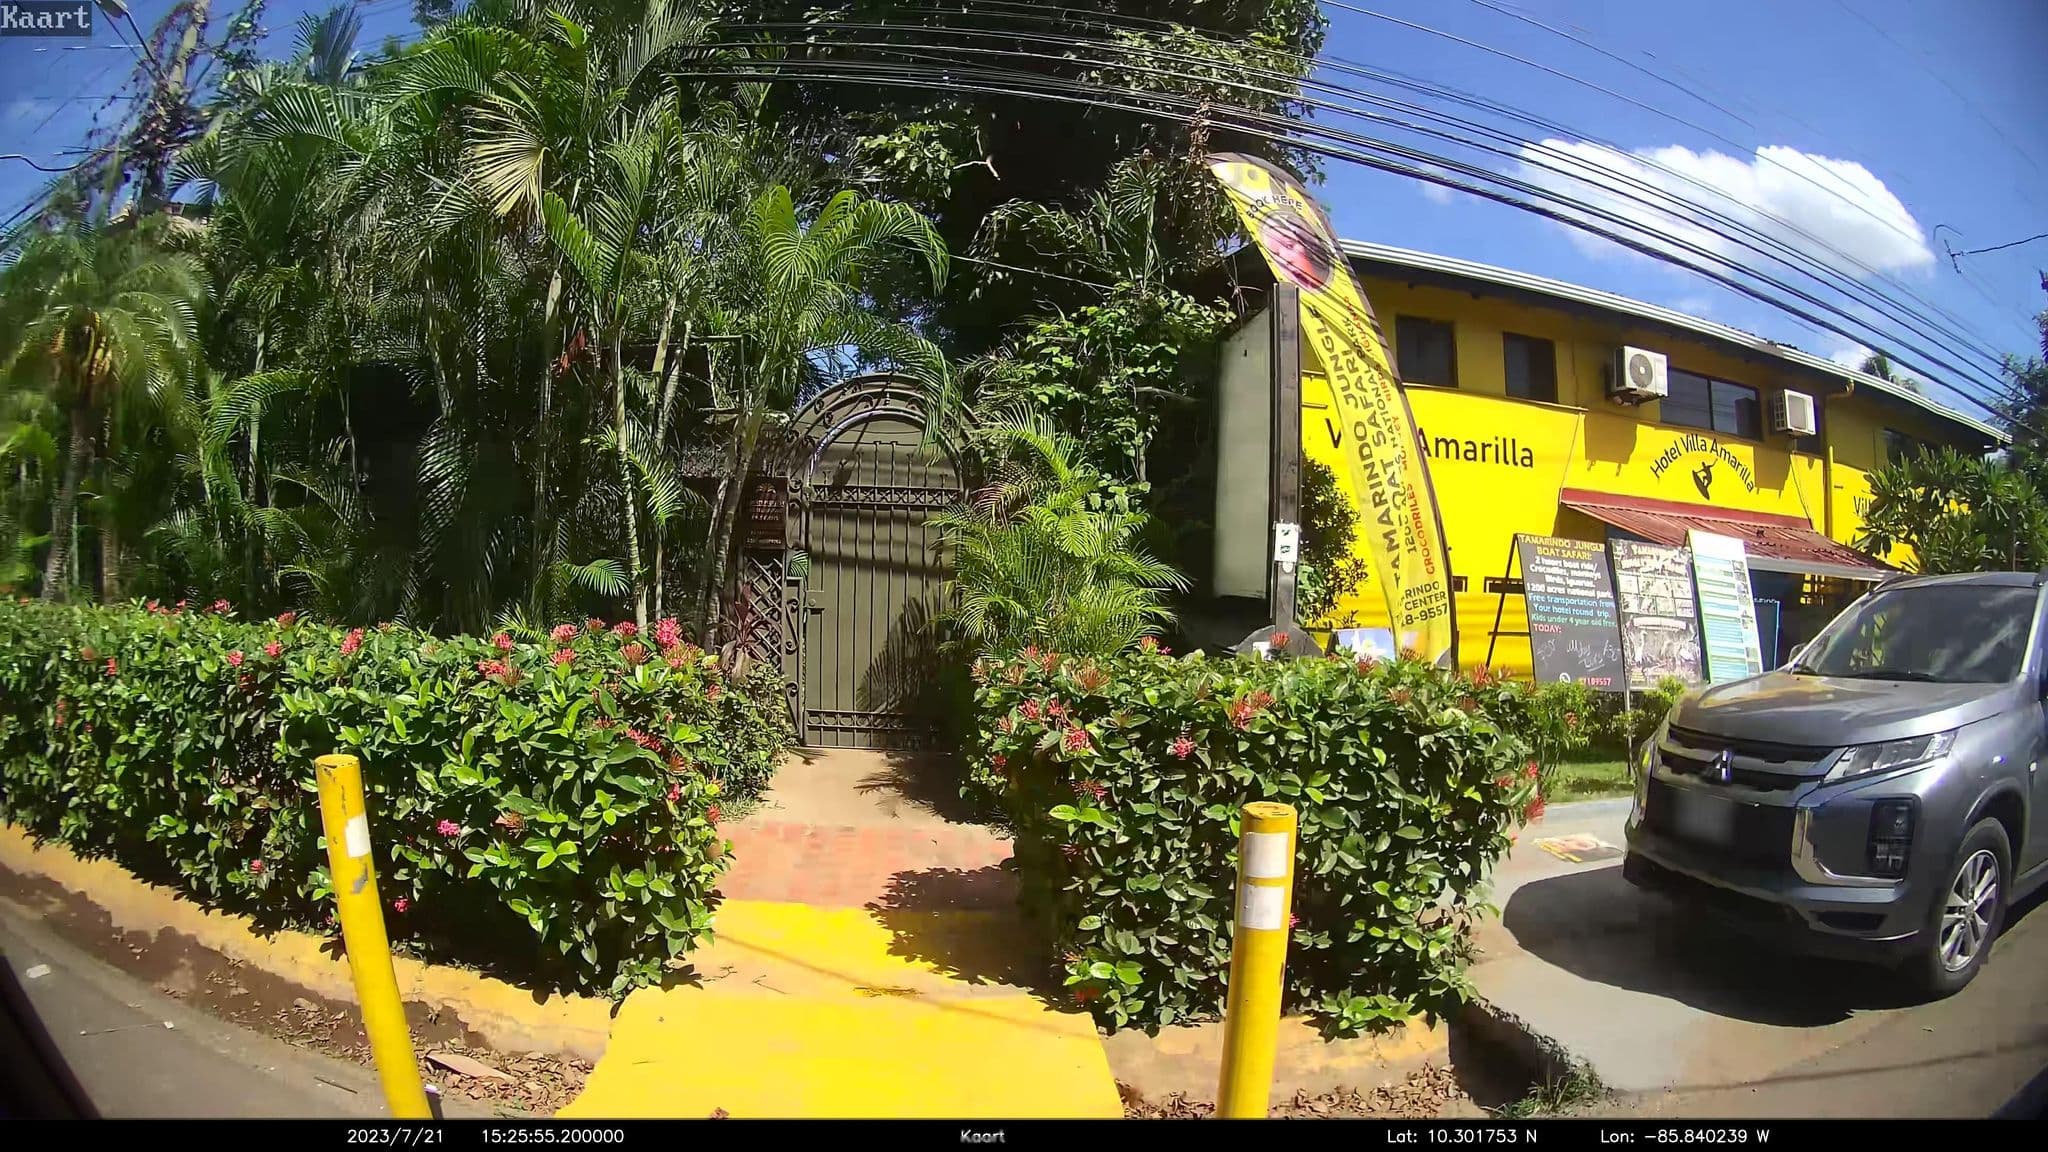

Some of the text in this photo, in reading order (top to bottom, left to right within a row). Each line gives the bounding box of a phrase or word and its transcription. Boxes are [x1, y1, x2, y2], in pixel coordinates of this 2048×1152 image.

[1272, 195, 1303, 211] HERE
[1308, 304, 1358, 409] JUNGLE
[1341, 350, 1386, 447] SAFARI
[1364, 364, 1399, 448] NATIONAL
[1416, 427, 1534, 469] Amarilla
[1650, 433, 1754, 493] Hotel Villa Amarilla
[1407, 483, 1435, 575] CROCODRILES
[1518, 534, 1605, 552] TAMARINDO JUNGLE
[1536, 546, 1561, 557] BOAT
[1404, 591, 1447, 611] CENTER
[1529, 592, 1546, 602] Free
[1547, 594, 1598, 607] transportation
[1552, 604, 1571, 614] hotel
[1572, 607, 1594, 616] round
[1531, 613, 1546, 622] Kids
[1547, 615, 1568, 624] under
[1574, 618, 1589, 627] year
[1533, 623, 1562, 634] TODAY:
